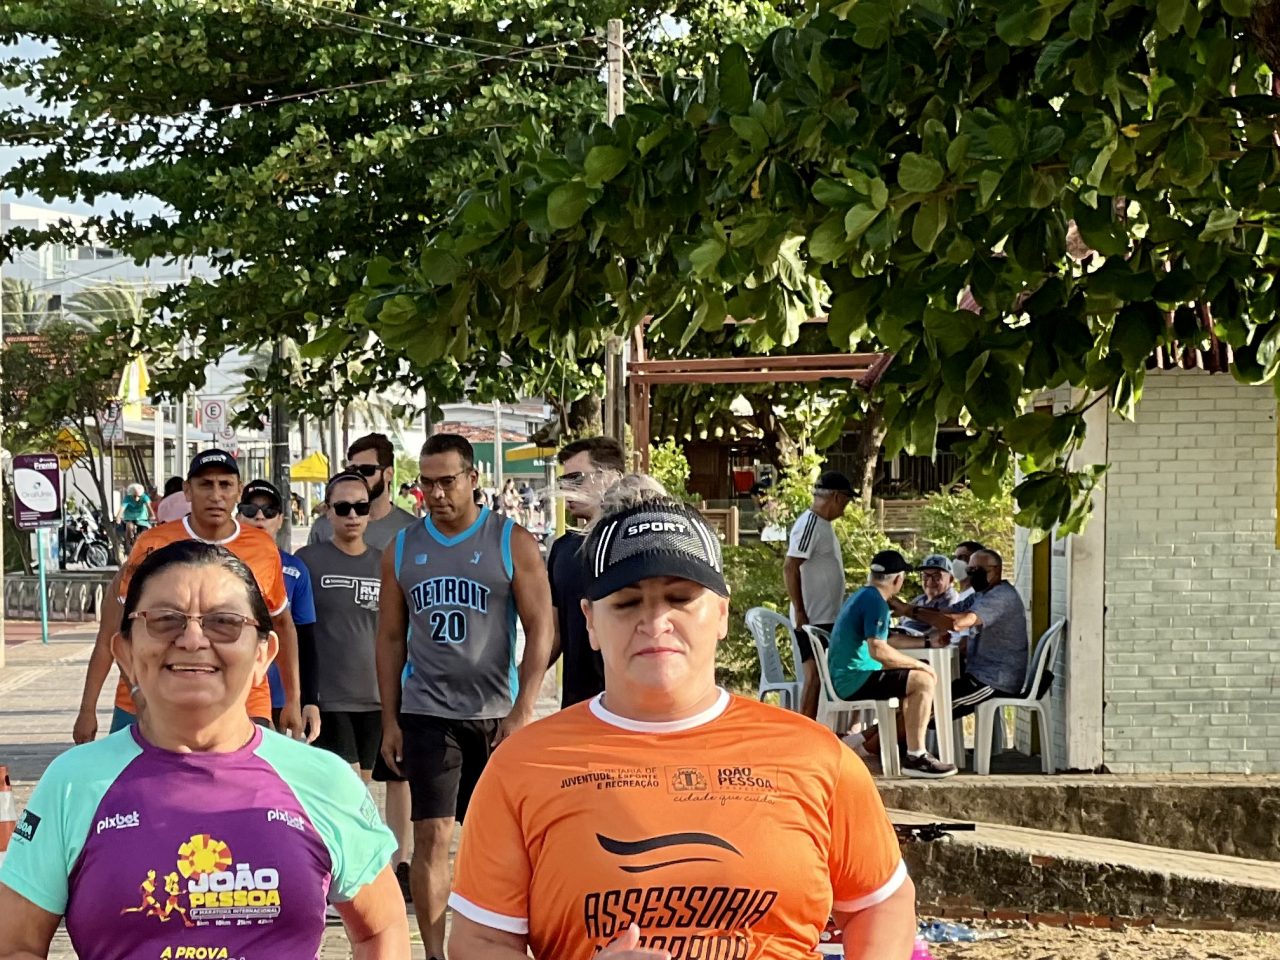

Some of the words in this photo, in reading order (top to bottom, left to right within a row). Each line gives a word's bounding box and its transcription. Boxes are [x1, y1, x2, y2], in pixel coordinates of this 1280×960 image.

[210, 406, 217, 416] E
[33, 462, 58, 471] Frente
[628, 522, 686, 536] SPORT
[409, 576, 491, 614] DETROIT
[429, 610, 467, 643] 20
[717, 766, 752, 778] JOÃO
[560, 772, 615, 789] JUVENTUDE,
[597, 781, 603, 790] E
[605, 780, 660, 789] RECREAÇÃO
[718, 776, 774, 790] PESSOA
[97, 811, 140, 834] pixbet
[267, 808, 306, 832] pixbet
[187, 863, 280, 893] JOÃO
[188, 889, 281, 908] PESSOA
[233, 907, 278, 915] INTERNACIONAL
[584, 886, 778, 939] ASSESSORIA
[160, 946, 172, 959] A
[175, 946, 229, 959] PROVA
